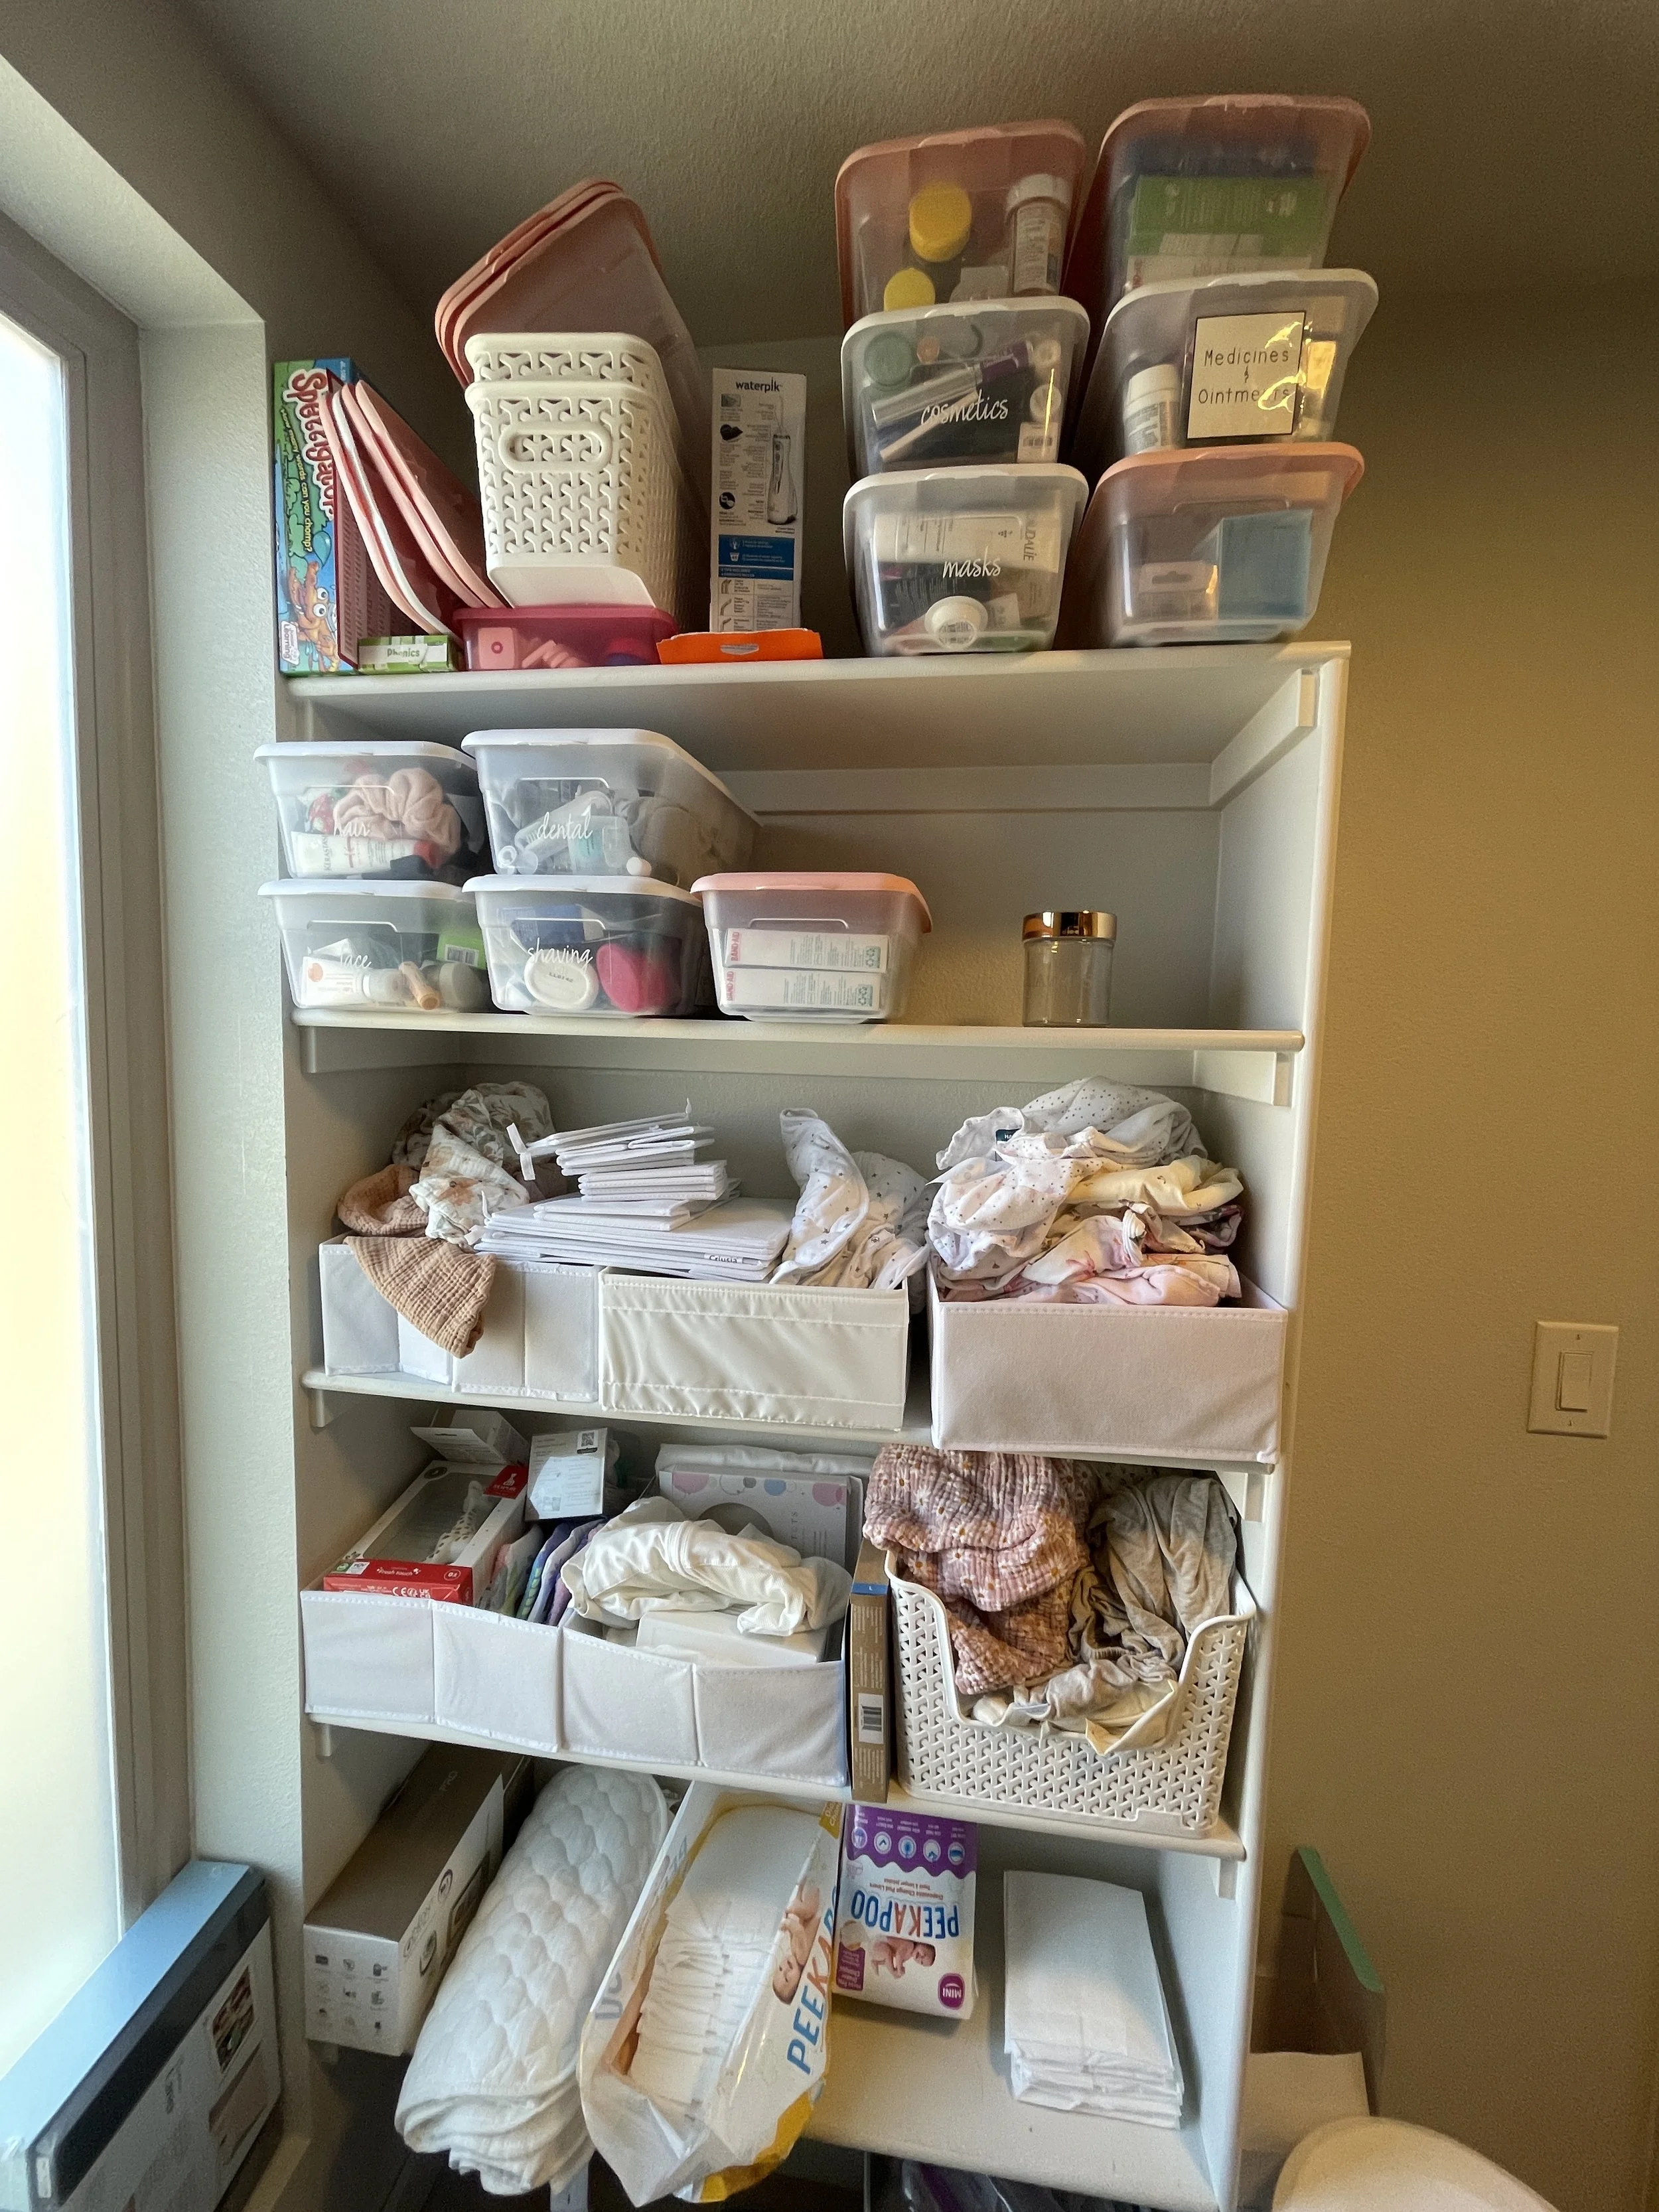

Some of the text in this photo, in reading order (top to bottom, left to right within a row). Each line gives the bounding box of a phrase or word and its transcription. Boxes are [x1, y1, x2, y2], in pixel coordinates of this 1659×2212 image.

[1204, 347, 1289, 366] Medicines
[736, 377, 780, 393] waterpik
[1198, 387, 1289, 404] Ointmets
[920, 389, 1009, 425] cosmetics
[289, 429, 300, 453] many
[296, 455, 307, 480] words
[302, 499, 311, 516] you
[303, 518, 313, 552] chomp?
[942, 545, 1001, 578] masks
[537, 811, 593, 840] dental
[528, 937, 593, 973] shaving
[731, 932, 739, 962] BAND-AID
[851, 1889, 960, 1939] PEEKAPOO
[942, 1987, 962, 1998] MINI
